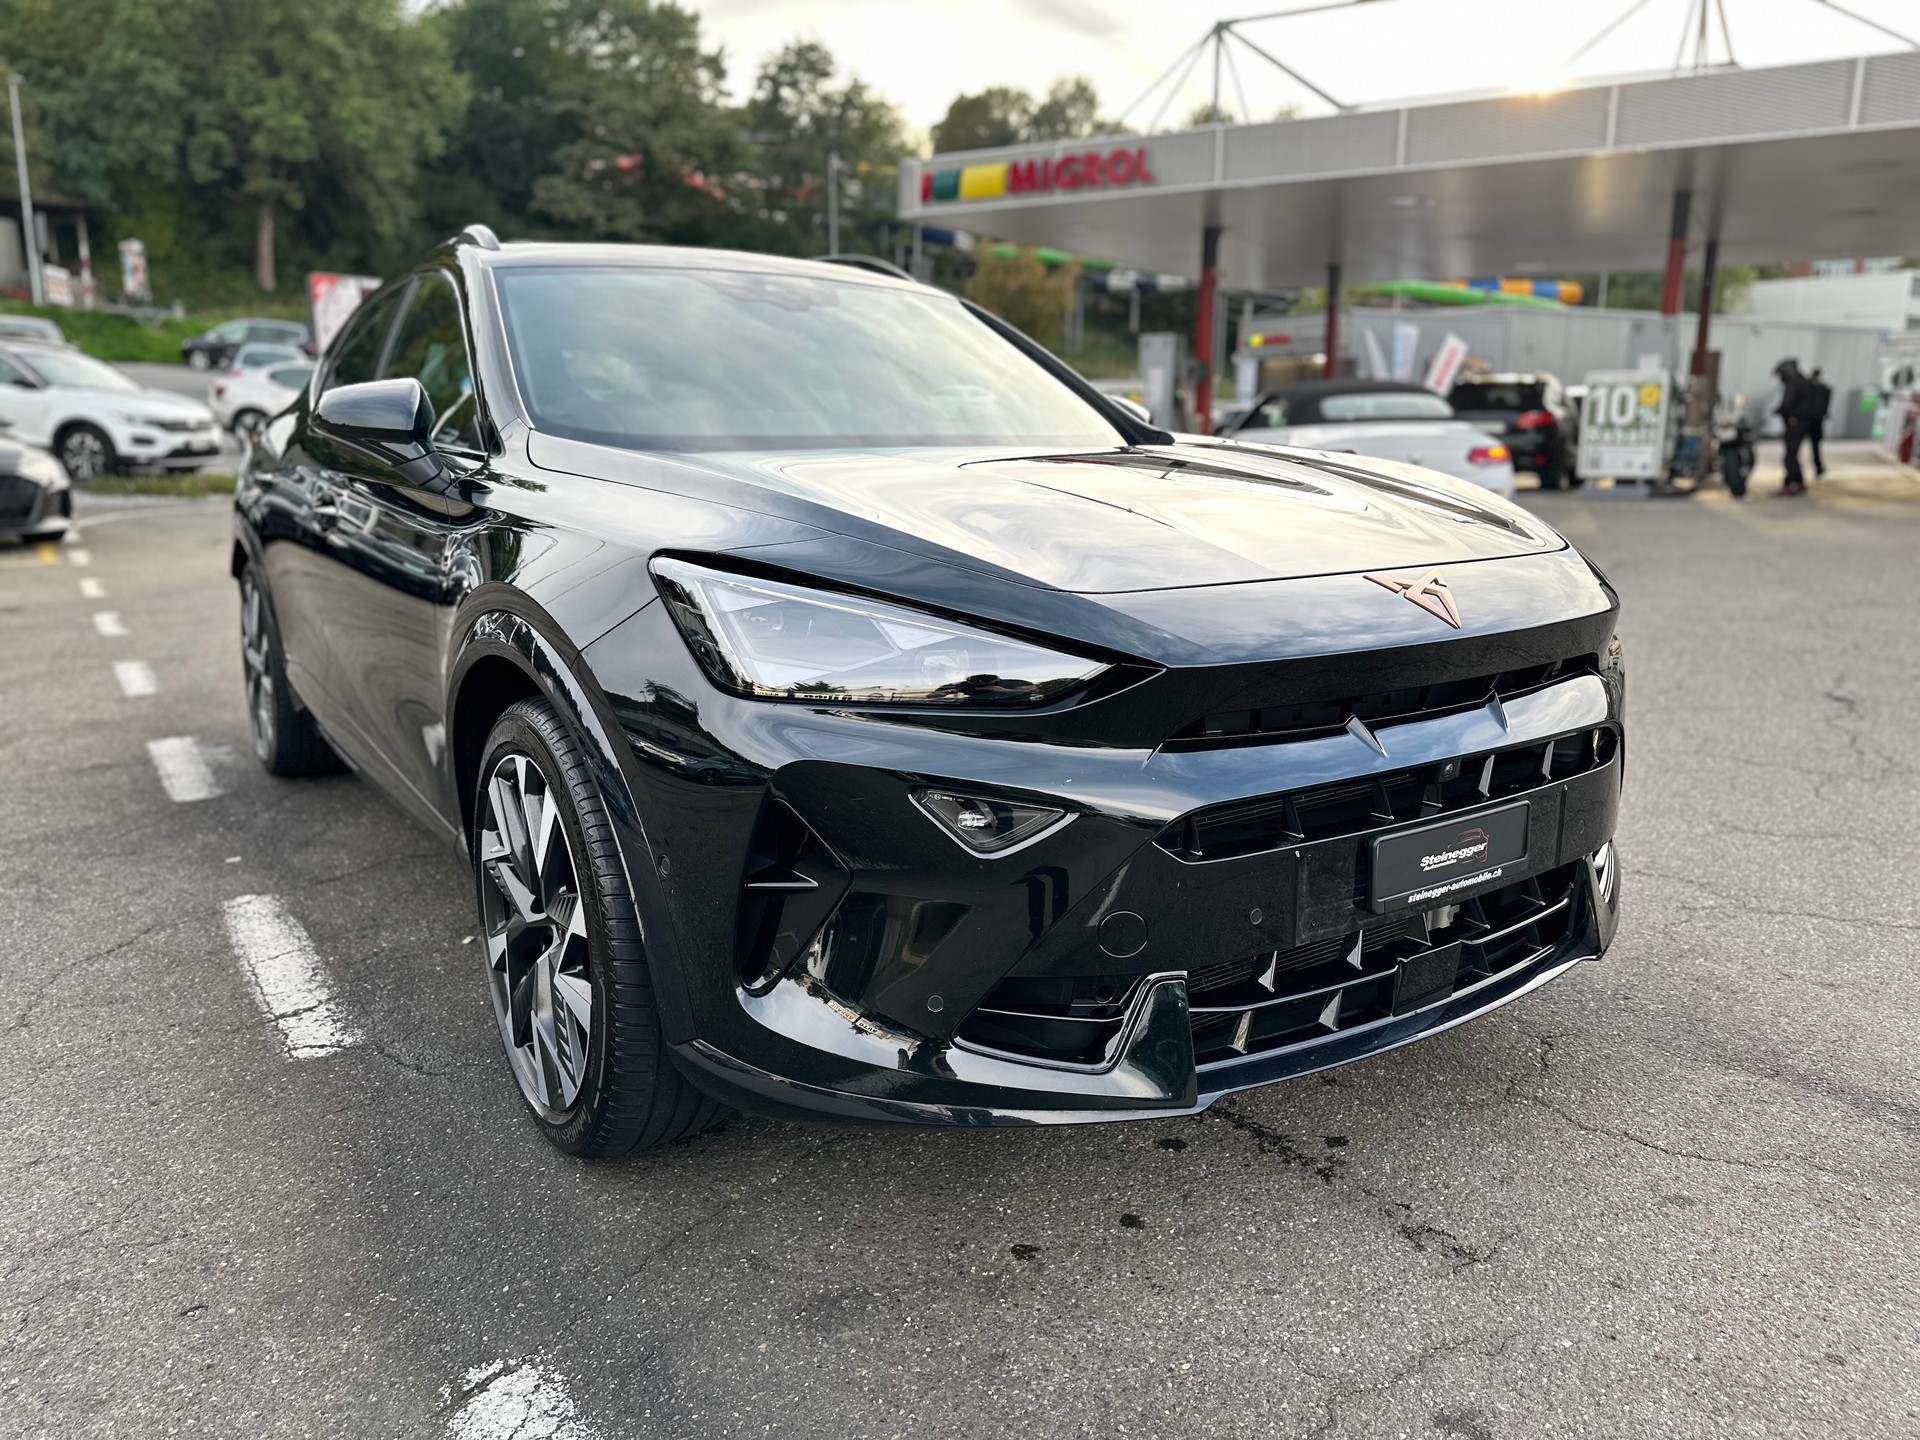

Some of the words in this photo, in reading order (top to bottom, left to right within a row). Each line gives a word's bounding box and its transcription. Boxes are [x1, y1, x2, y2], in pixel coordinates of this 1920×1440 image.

[1008, 147, 1153, 194] MIGROL
[1420, 842, 1487, 867] Steinegger
[1407, 867, 1503, 903] steinegger-automobile.ch
